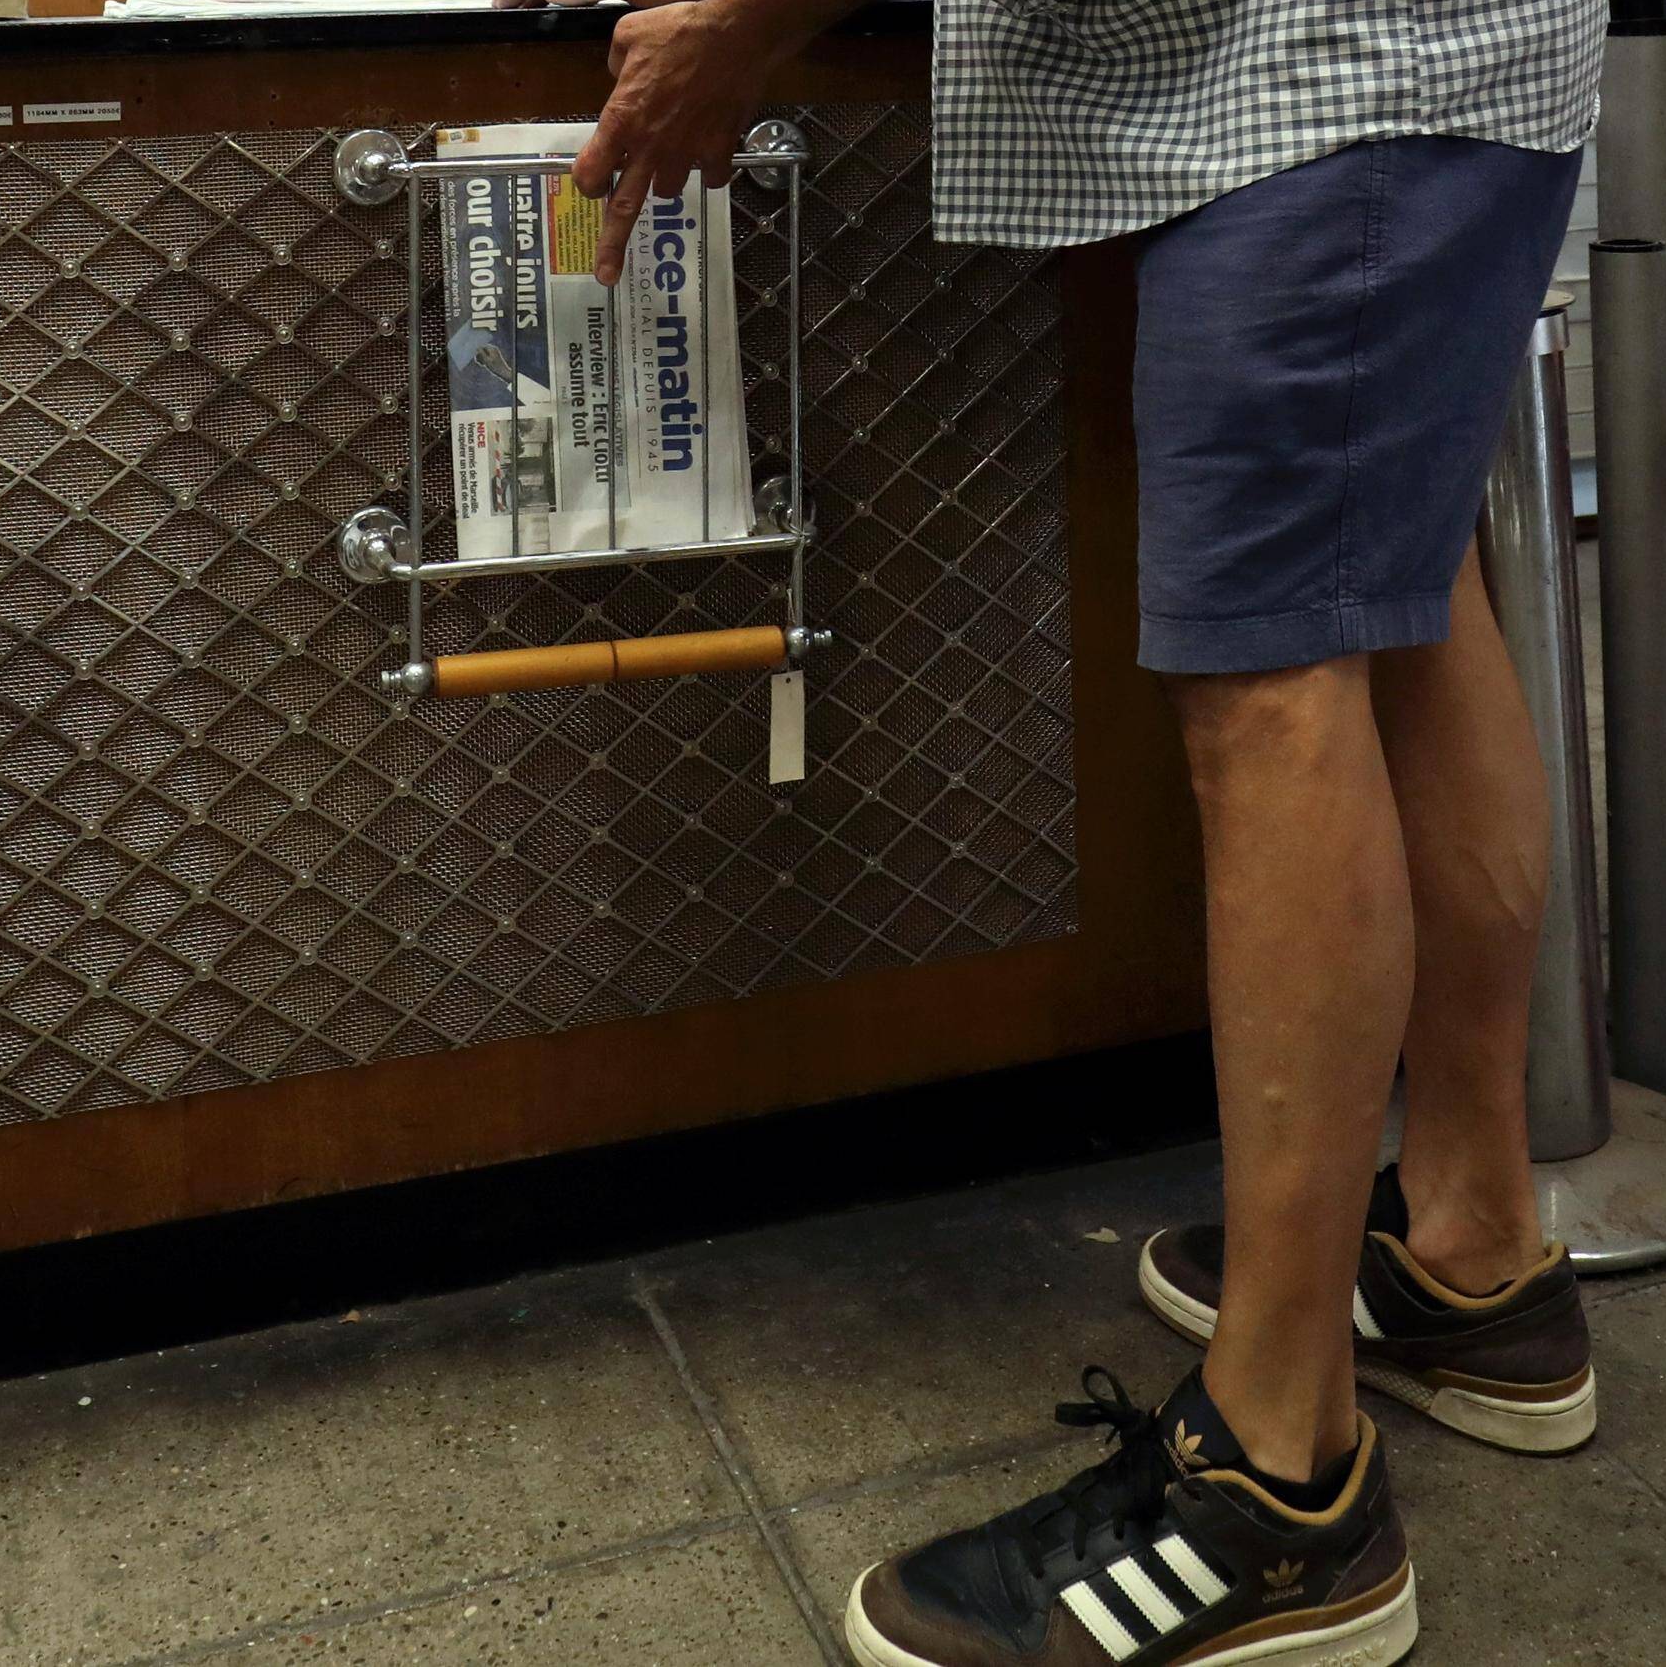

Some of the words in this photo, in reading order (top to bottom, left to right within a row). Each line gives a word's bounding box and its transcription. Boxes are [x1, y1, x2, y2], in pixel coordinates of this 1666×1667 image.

[448, 181, 456, 197] des
[448, 199, 457, 226] forces
[636, 198, 651, 254] SEAU
[449, 227, 456, 238] en
[450, 241, 459, 281] présence
[452, 283, 460, 307] après
[467, 236, 503, 332] choisir
[453, 308, 461, 317] la
[638, 267, 653, 335] SOCIAL
[651, 193, 706, 472] nice-matin
[585, 306, 605, 387] Interview
[567, 342, 587, 406] assume
[641, 348, 656, 413] DEPUIS
[458, 423, 467, 458] récupérer
[468, 422, 476, 444] Venus
[477, 421, 485, 448] NICE
[571, 411, 590, 447] tout
[468, 446, 477, 469] armés
[645, 427, 658, 473] 1945
[460, 459, 467, 469] un
[469, 470, 477, 480] de
[460, 471, 469, 490] point
[461, 491, 469, 501] de
[470, 481, 479, 514] Marseille
[462, 503, 470, 519] deal
[1162, 1437, 1190, 1480] adida
[1262, 1585, 1304, 1603] adidas
